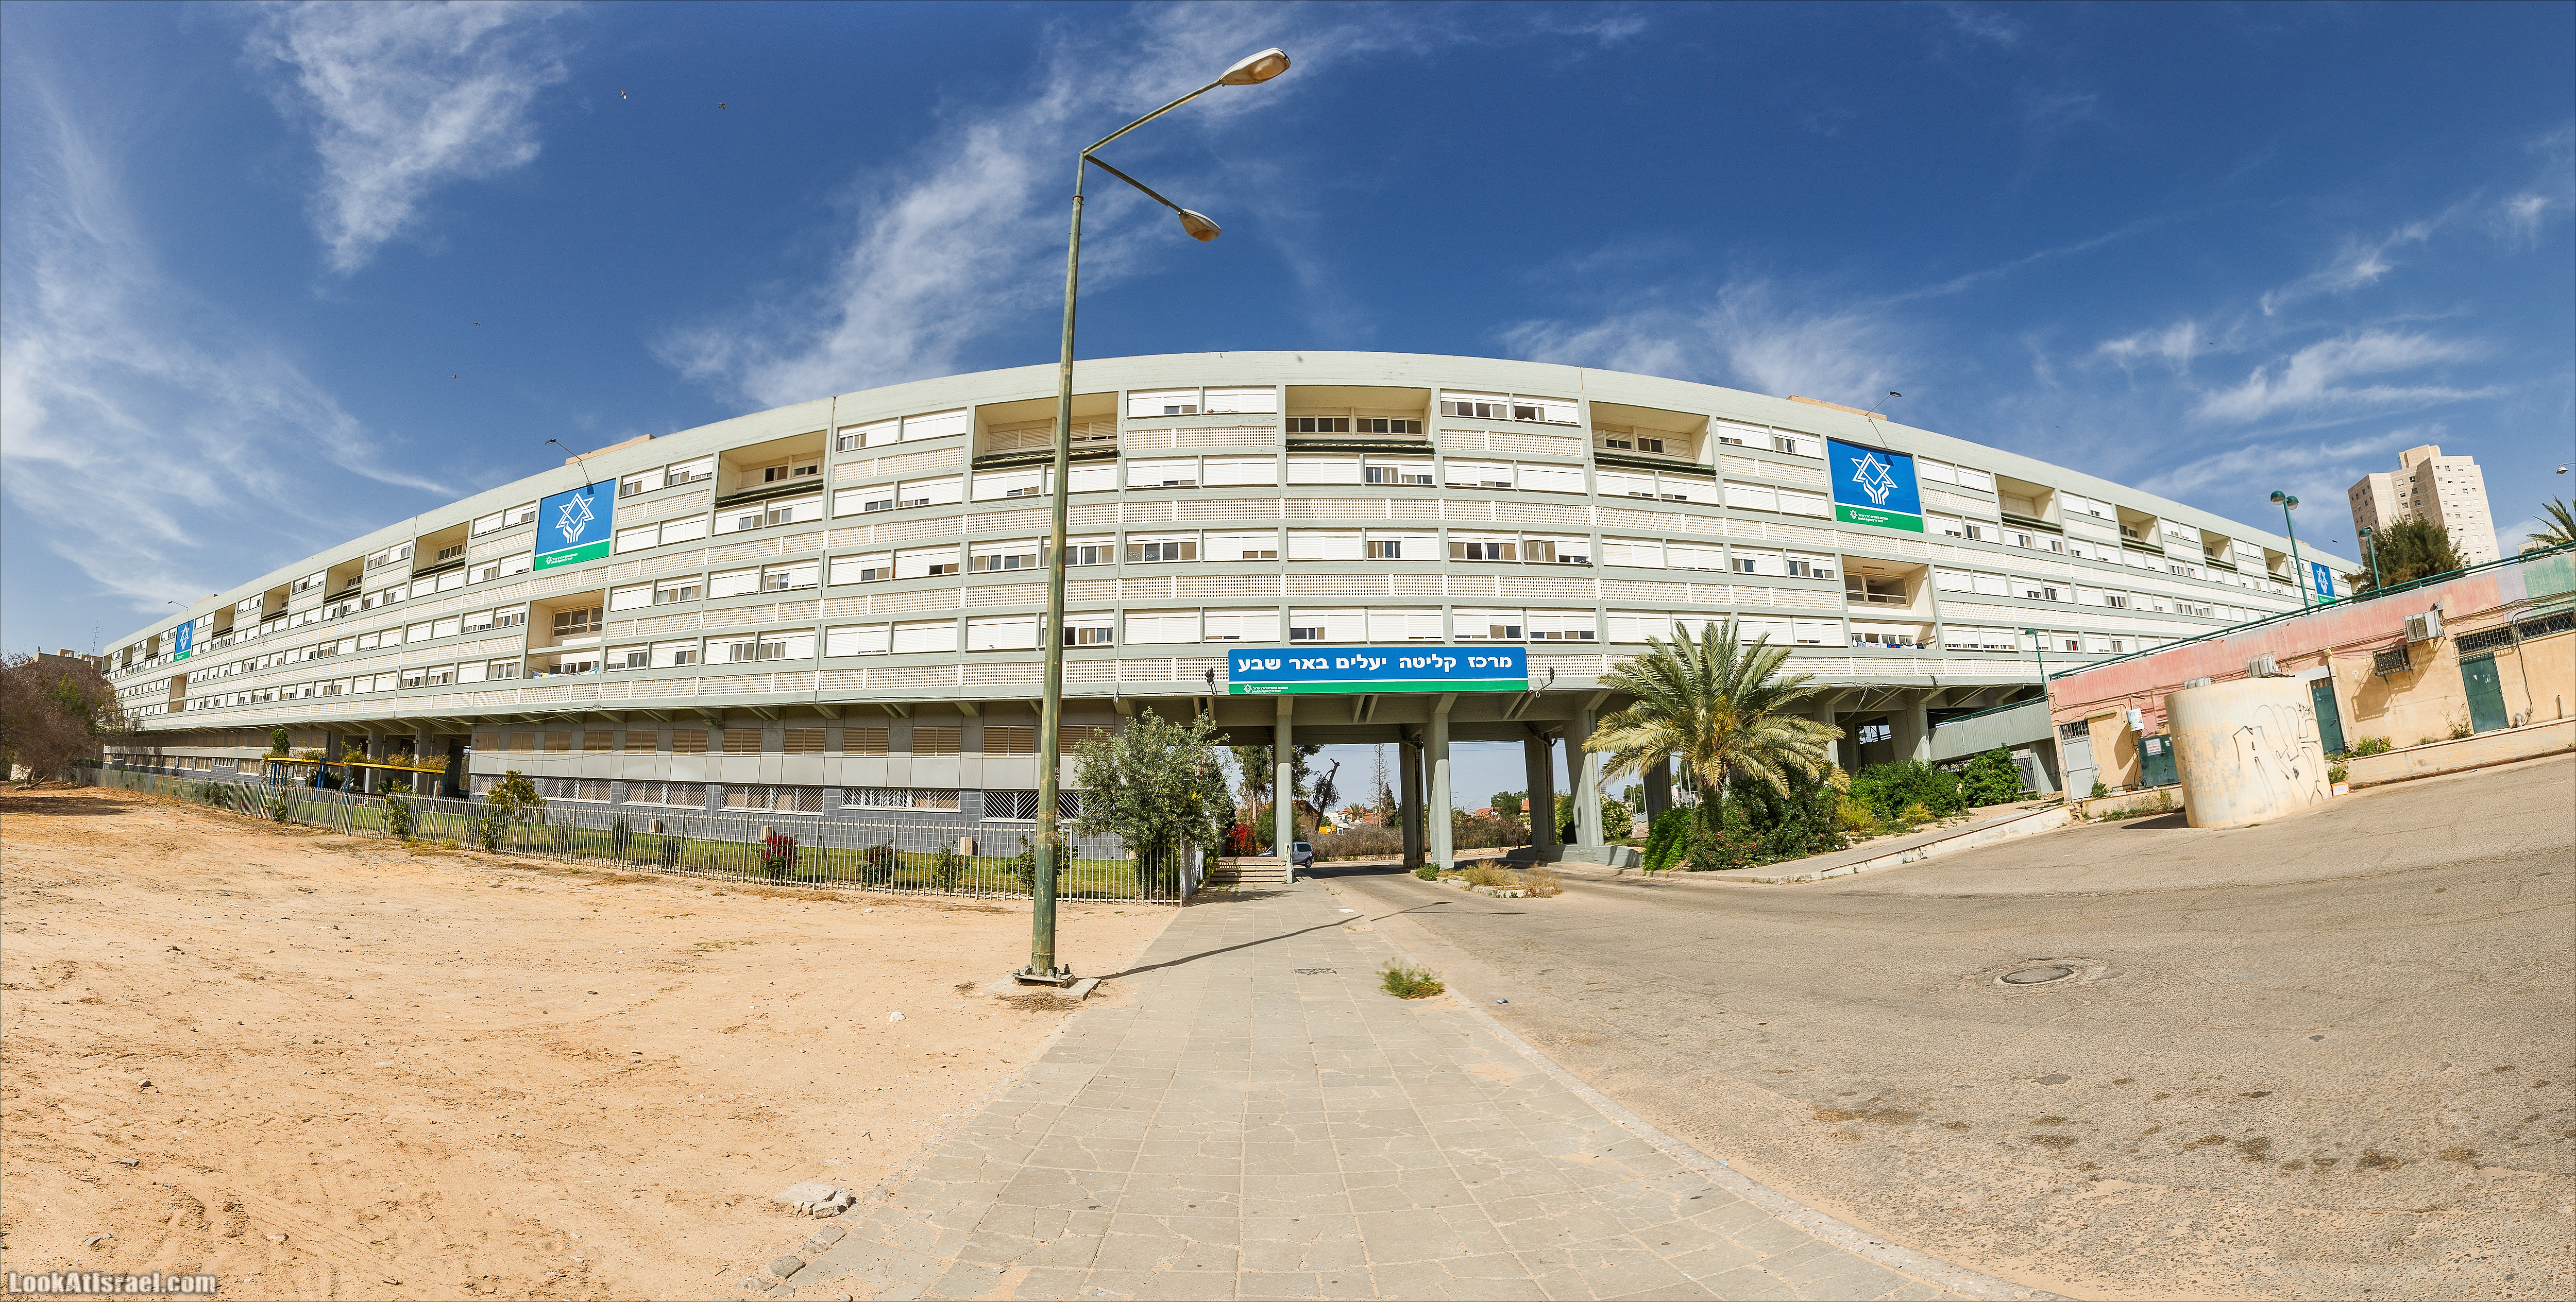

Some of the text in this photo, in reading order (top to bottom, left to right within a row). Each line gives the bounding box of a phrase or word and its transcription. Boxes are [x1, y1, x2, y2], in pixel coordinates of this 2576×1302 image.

[1238, 653, 1513, 673] מרכז קליטה יעלים באר שבע
